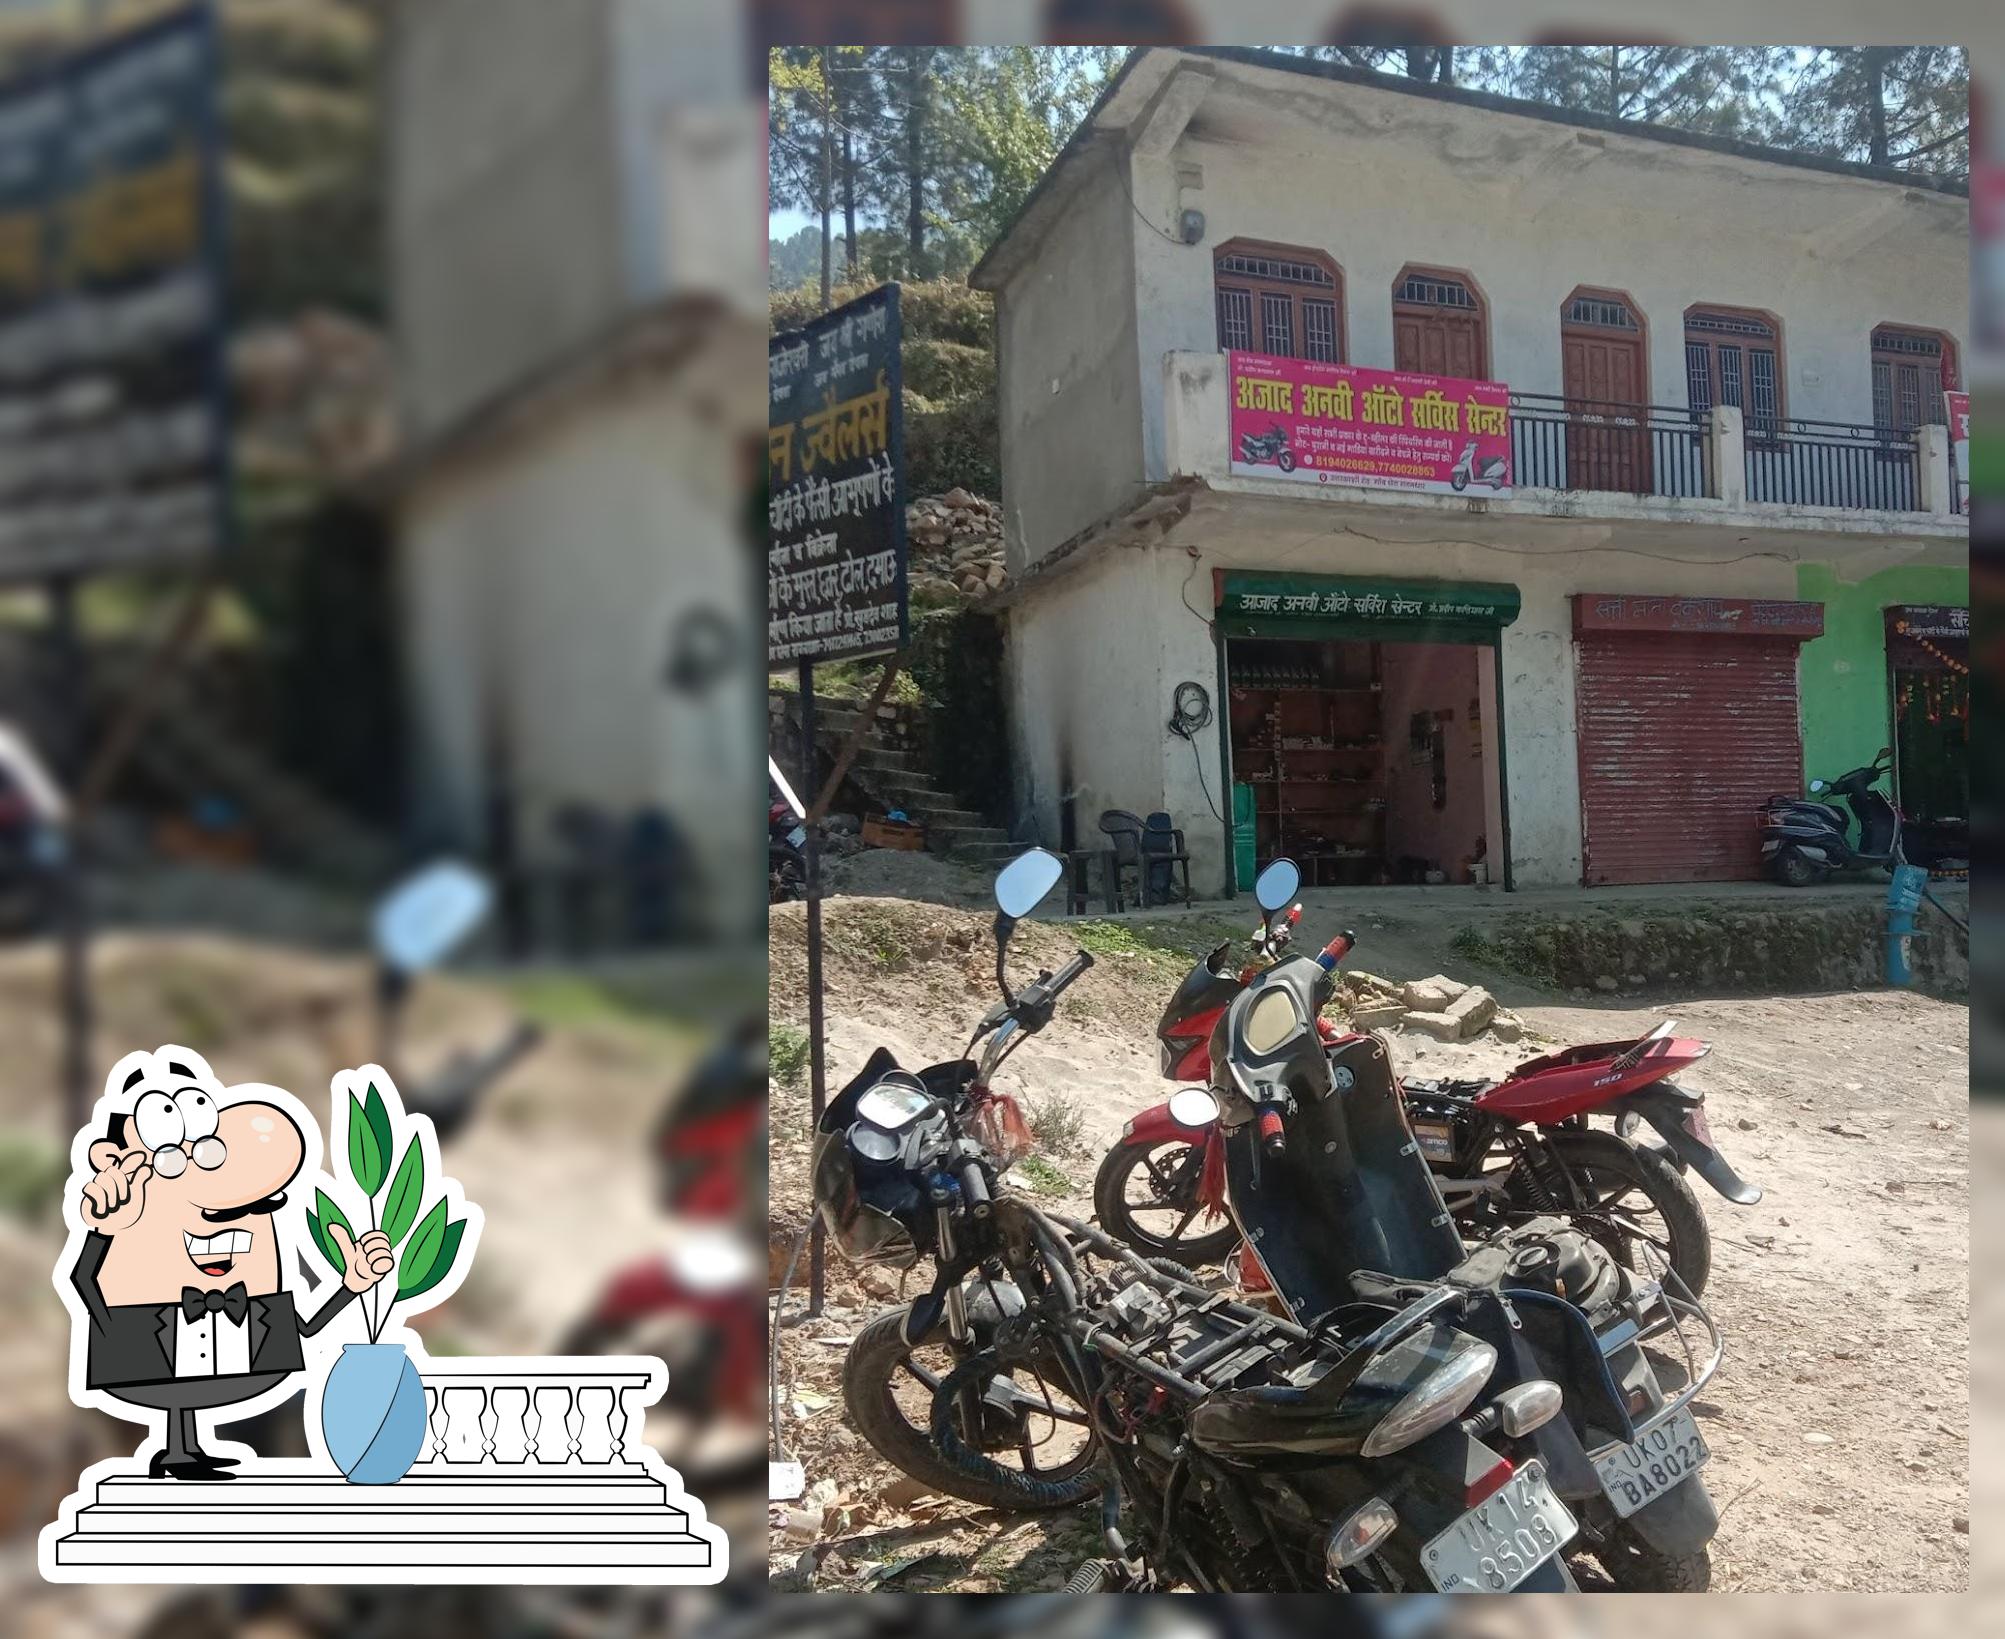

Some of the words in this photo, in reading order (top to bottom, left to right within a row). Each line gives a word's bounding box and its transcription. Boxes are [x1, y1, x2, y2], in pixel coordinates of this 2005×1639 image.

[1301, 379, 1354, 421] अनवी
[1465, 394, 1507, 437] सेन्टर
[1621, 1436, 1708, 1506] BA8022
[1441, 1573, 1460, 1592] IND
